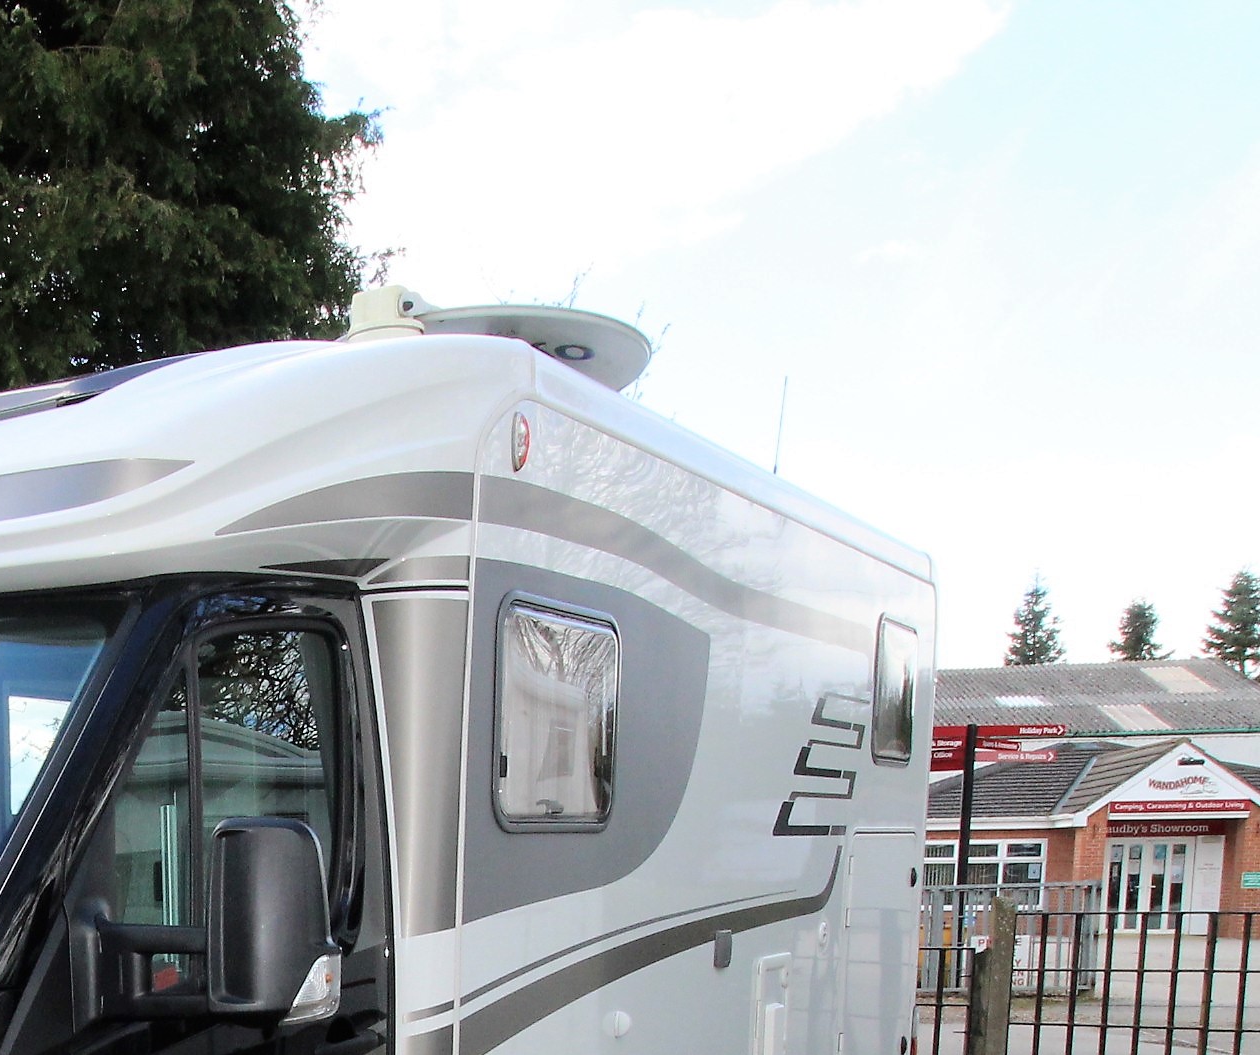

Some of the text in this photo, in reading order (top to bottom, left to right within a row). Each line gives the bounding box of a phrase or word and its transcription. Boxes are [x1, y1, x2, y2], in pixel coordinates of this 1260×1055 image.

[1019, 726, 1058, 735] Holiday Park
[1146, 802, 1187, 811] Caravanning
[1188, 801, 1194, 809] &
[1195, 801, 1224, 809] Outdoor
[1225, 801, 1245, 810] Living
[1150, 823, 1209, 833] Showroom
